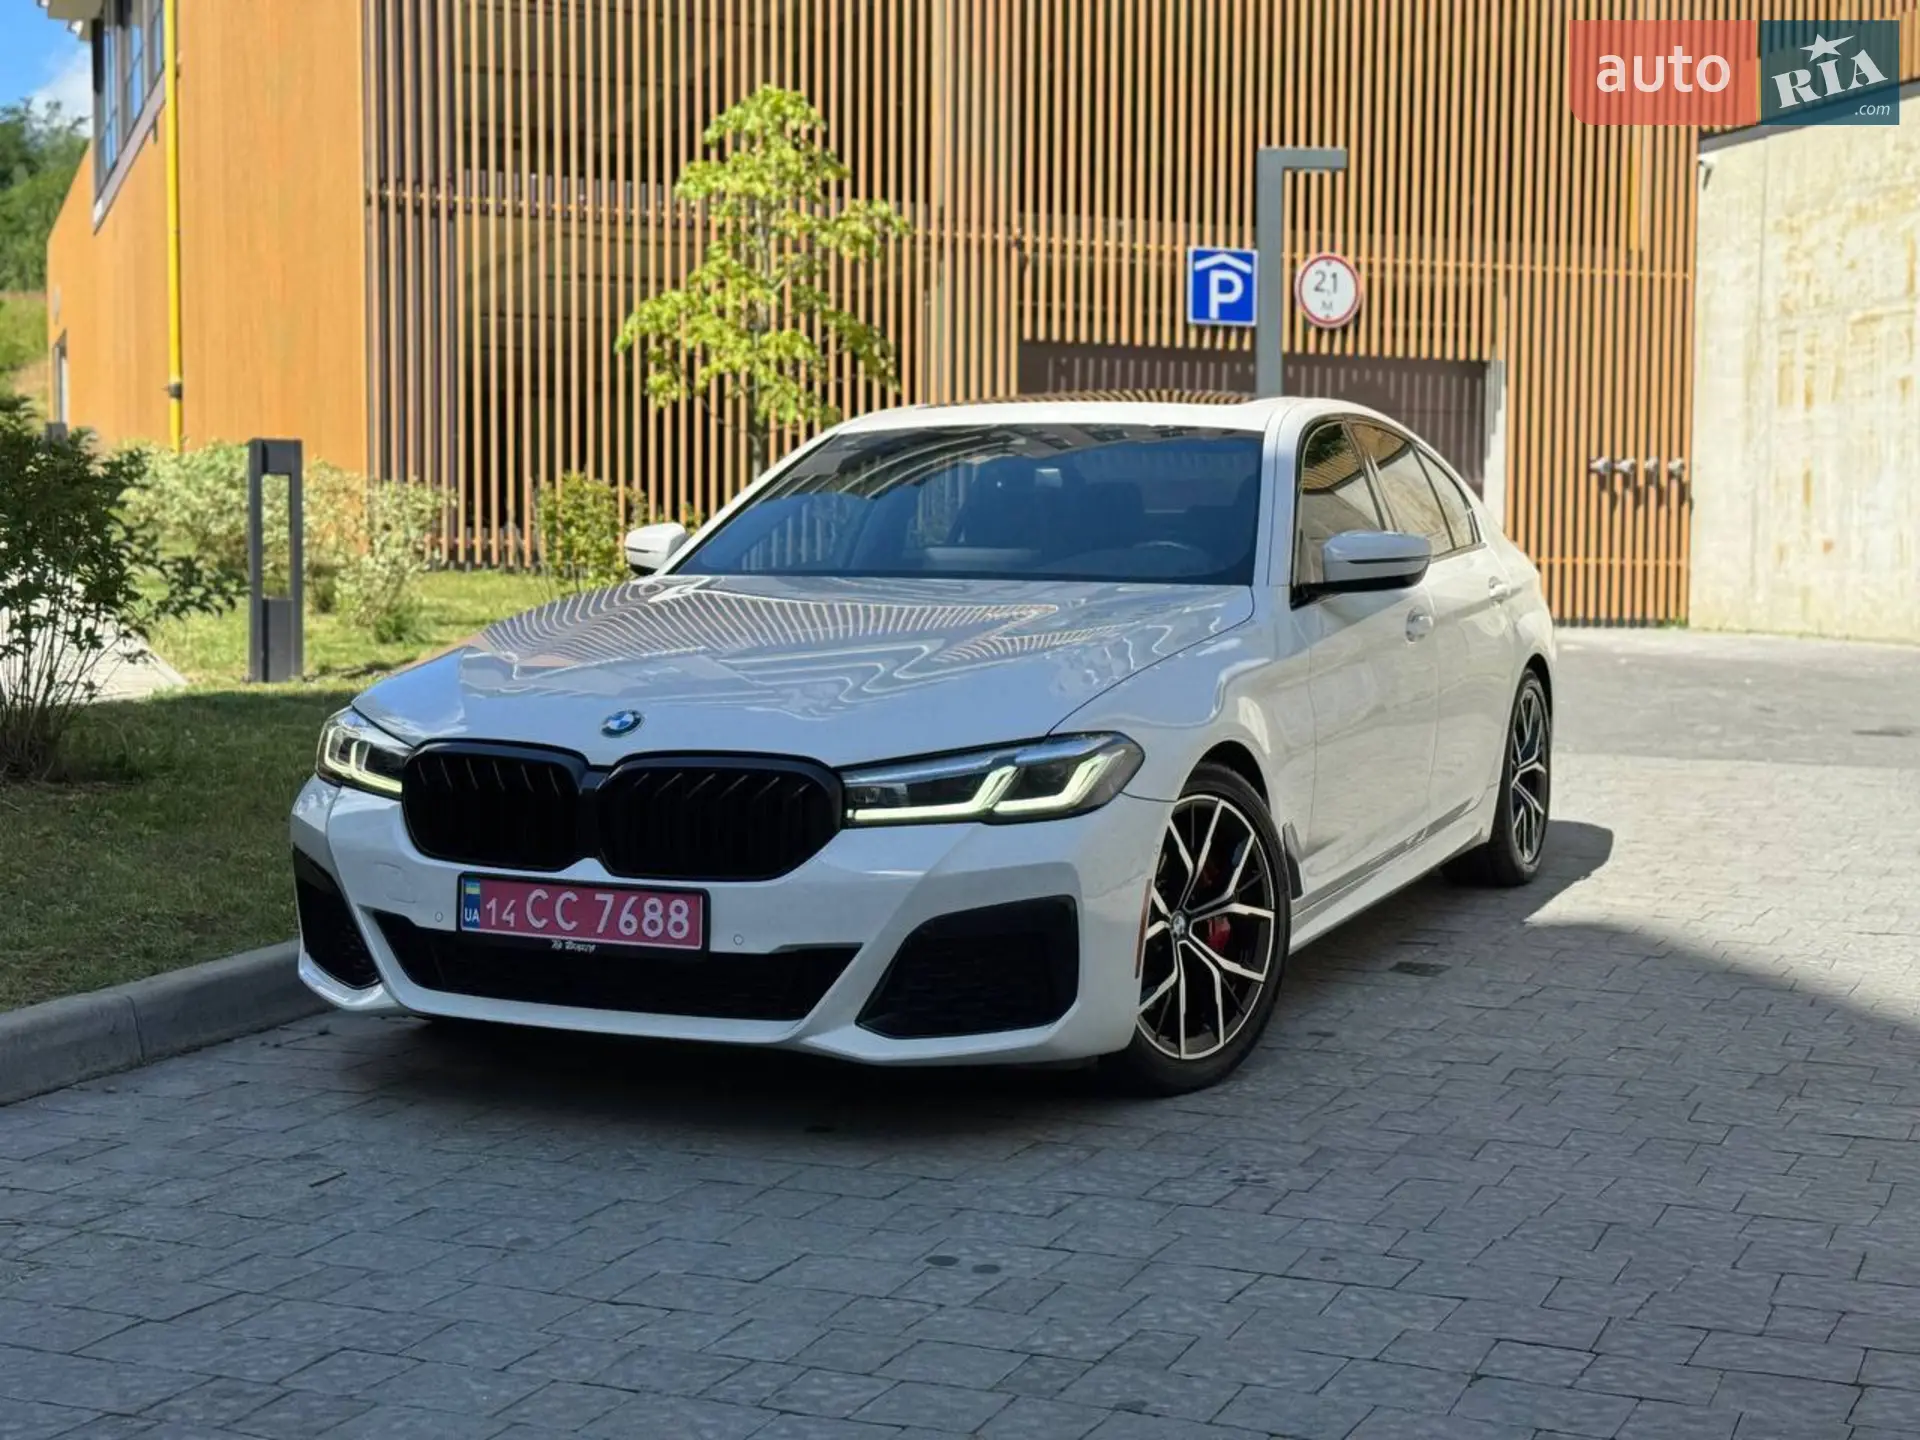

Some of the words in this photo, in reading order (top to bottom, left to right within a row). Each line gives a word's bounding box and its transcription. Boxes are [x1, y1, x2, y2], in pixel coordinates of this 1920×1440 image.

[1208, 269, 1244, 320] P
[464, 907, 480, 923] UA
[486, 897, 516, 928] 14
[525, 888, 579, 931] CC
[594, 893, 690, 940] 7688
